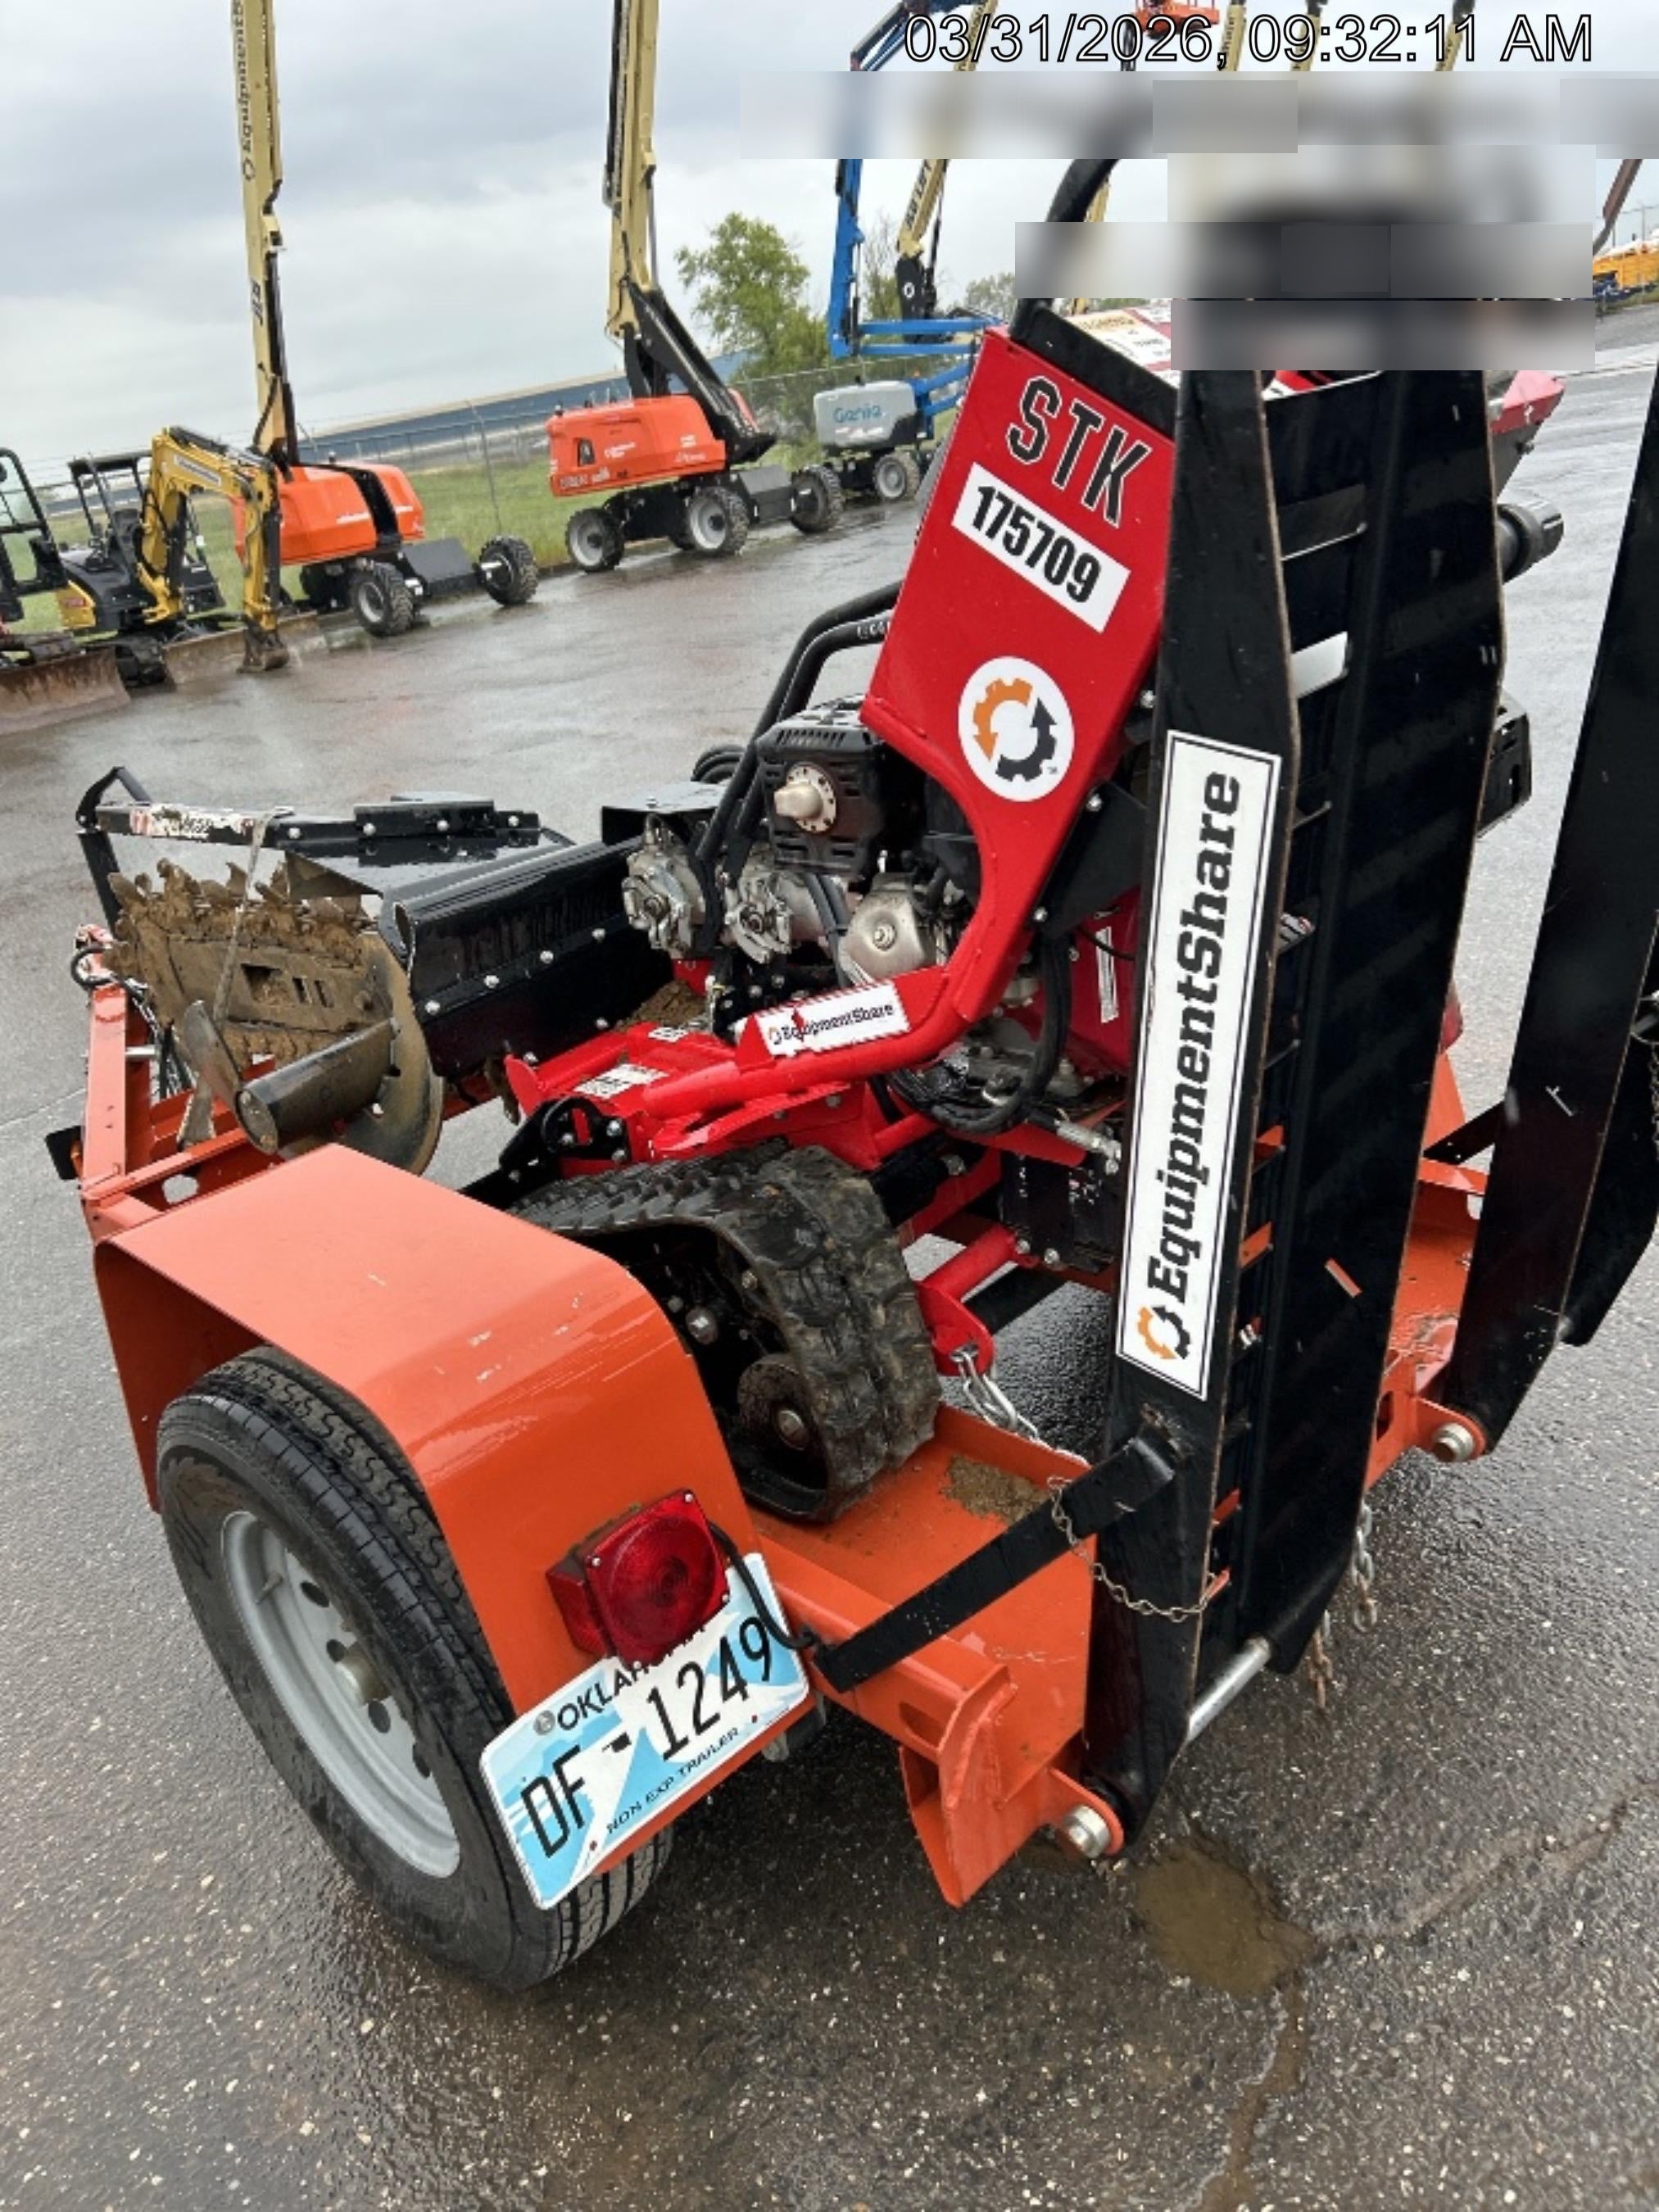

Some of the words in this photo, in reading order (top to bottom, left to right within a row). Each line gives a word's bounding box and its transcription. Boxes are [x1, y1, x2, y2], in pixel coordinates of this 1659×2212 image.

[833, 403, 882, 423] Genie
[1005, 375, 1153, 528] STK
[972, 485, 1102, 603] 175709
[1147, 771, 1240, 1305] EquipmentShare
[519, 1744, 586, 1859] DF
[646, 1616, 773, 1761] 1249
[606, 1800, 642, 1834] NON
[646, 1775, 675, 1803] EXP
[678, 1726, 740, 1777] TRAILER
